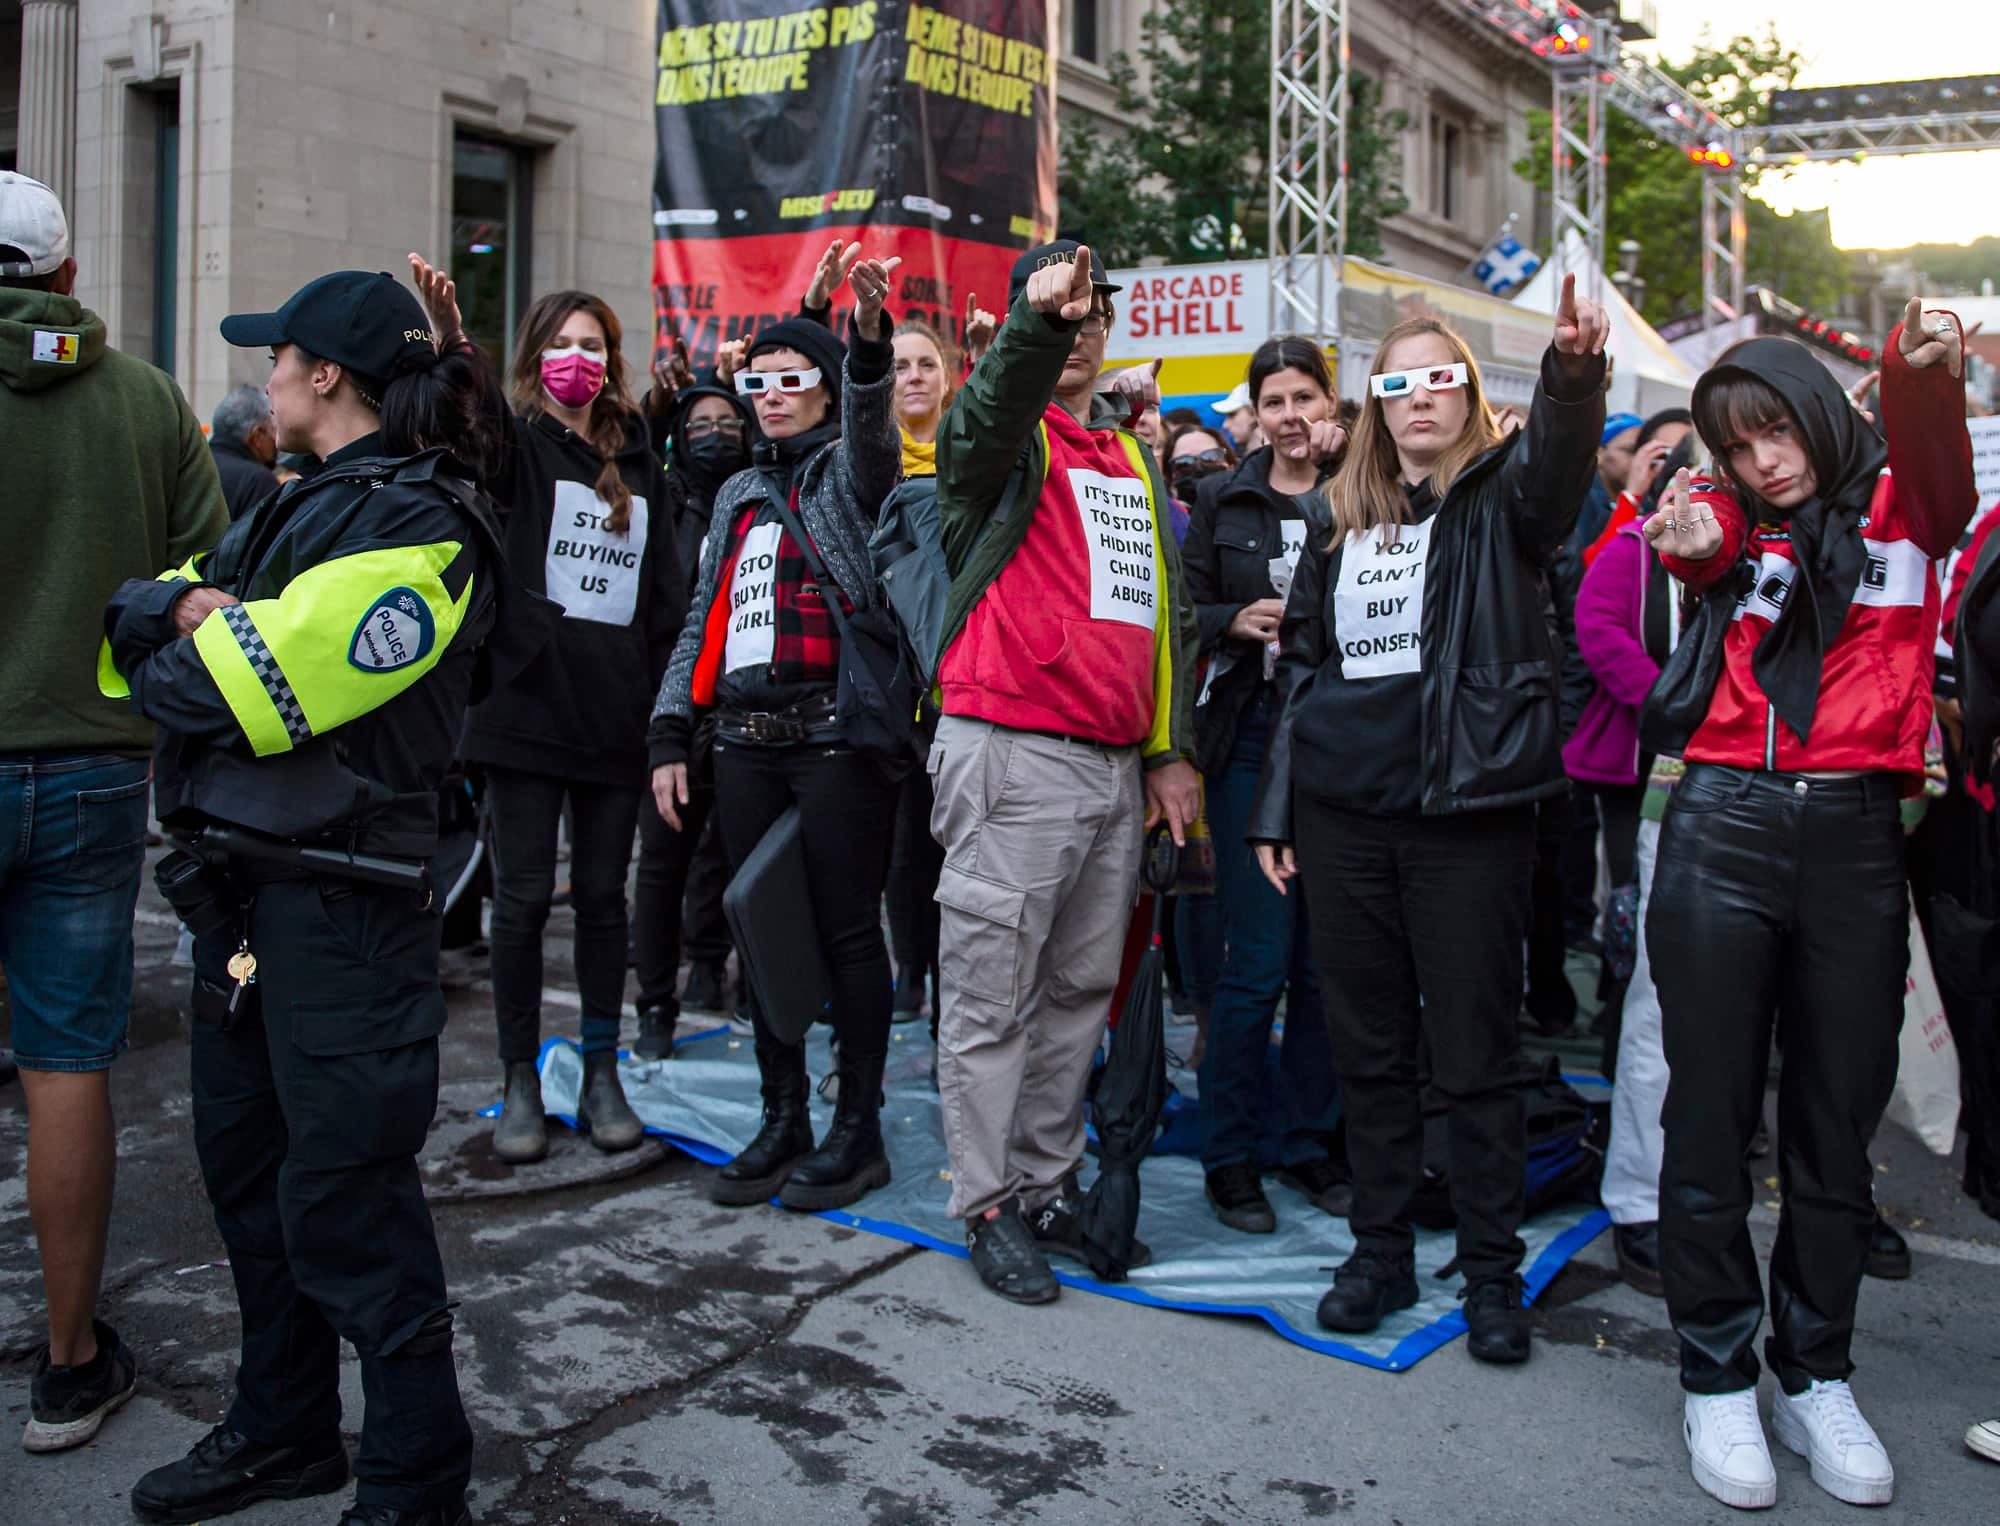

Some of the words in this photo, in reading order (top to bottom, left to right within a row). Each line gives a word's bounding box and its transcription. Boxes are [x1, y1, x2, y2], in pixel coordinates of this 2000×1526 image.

[742, 18, 775, 57] TU
[980, 30, 1004, 70] TU
[1130, 273, 1242, 302] ARCADE
[1130, 301, 1244, 338] SHELL
[1084, 485, 1109, 504] IT'S
[1112, 493, 1151, 510] TIME
[1090, 509, 1110, 526] TO
[1113, 515, 1153, 533] STOP
[554, 540, 637, 569] BUYING
[1100, 533, 1153, 558] HIDING
[1374, 539, 1420, 556] YOU
[1109, 559, 1151, 582] CHILD
[1357, 562, 1422, 586] CAN'T
[580, 575, 609, 594] US
[1111, 584, 1153, 608] ABUSE
[1367, 596, 1408, 619] BUY
[376, 609, 406, 663] POLICE
